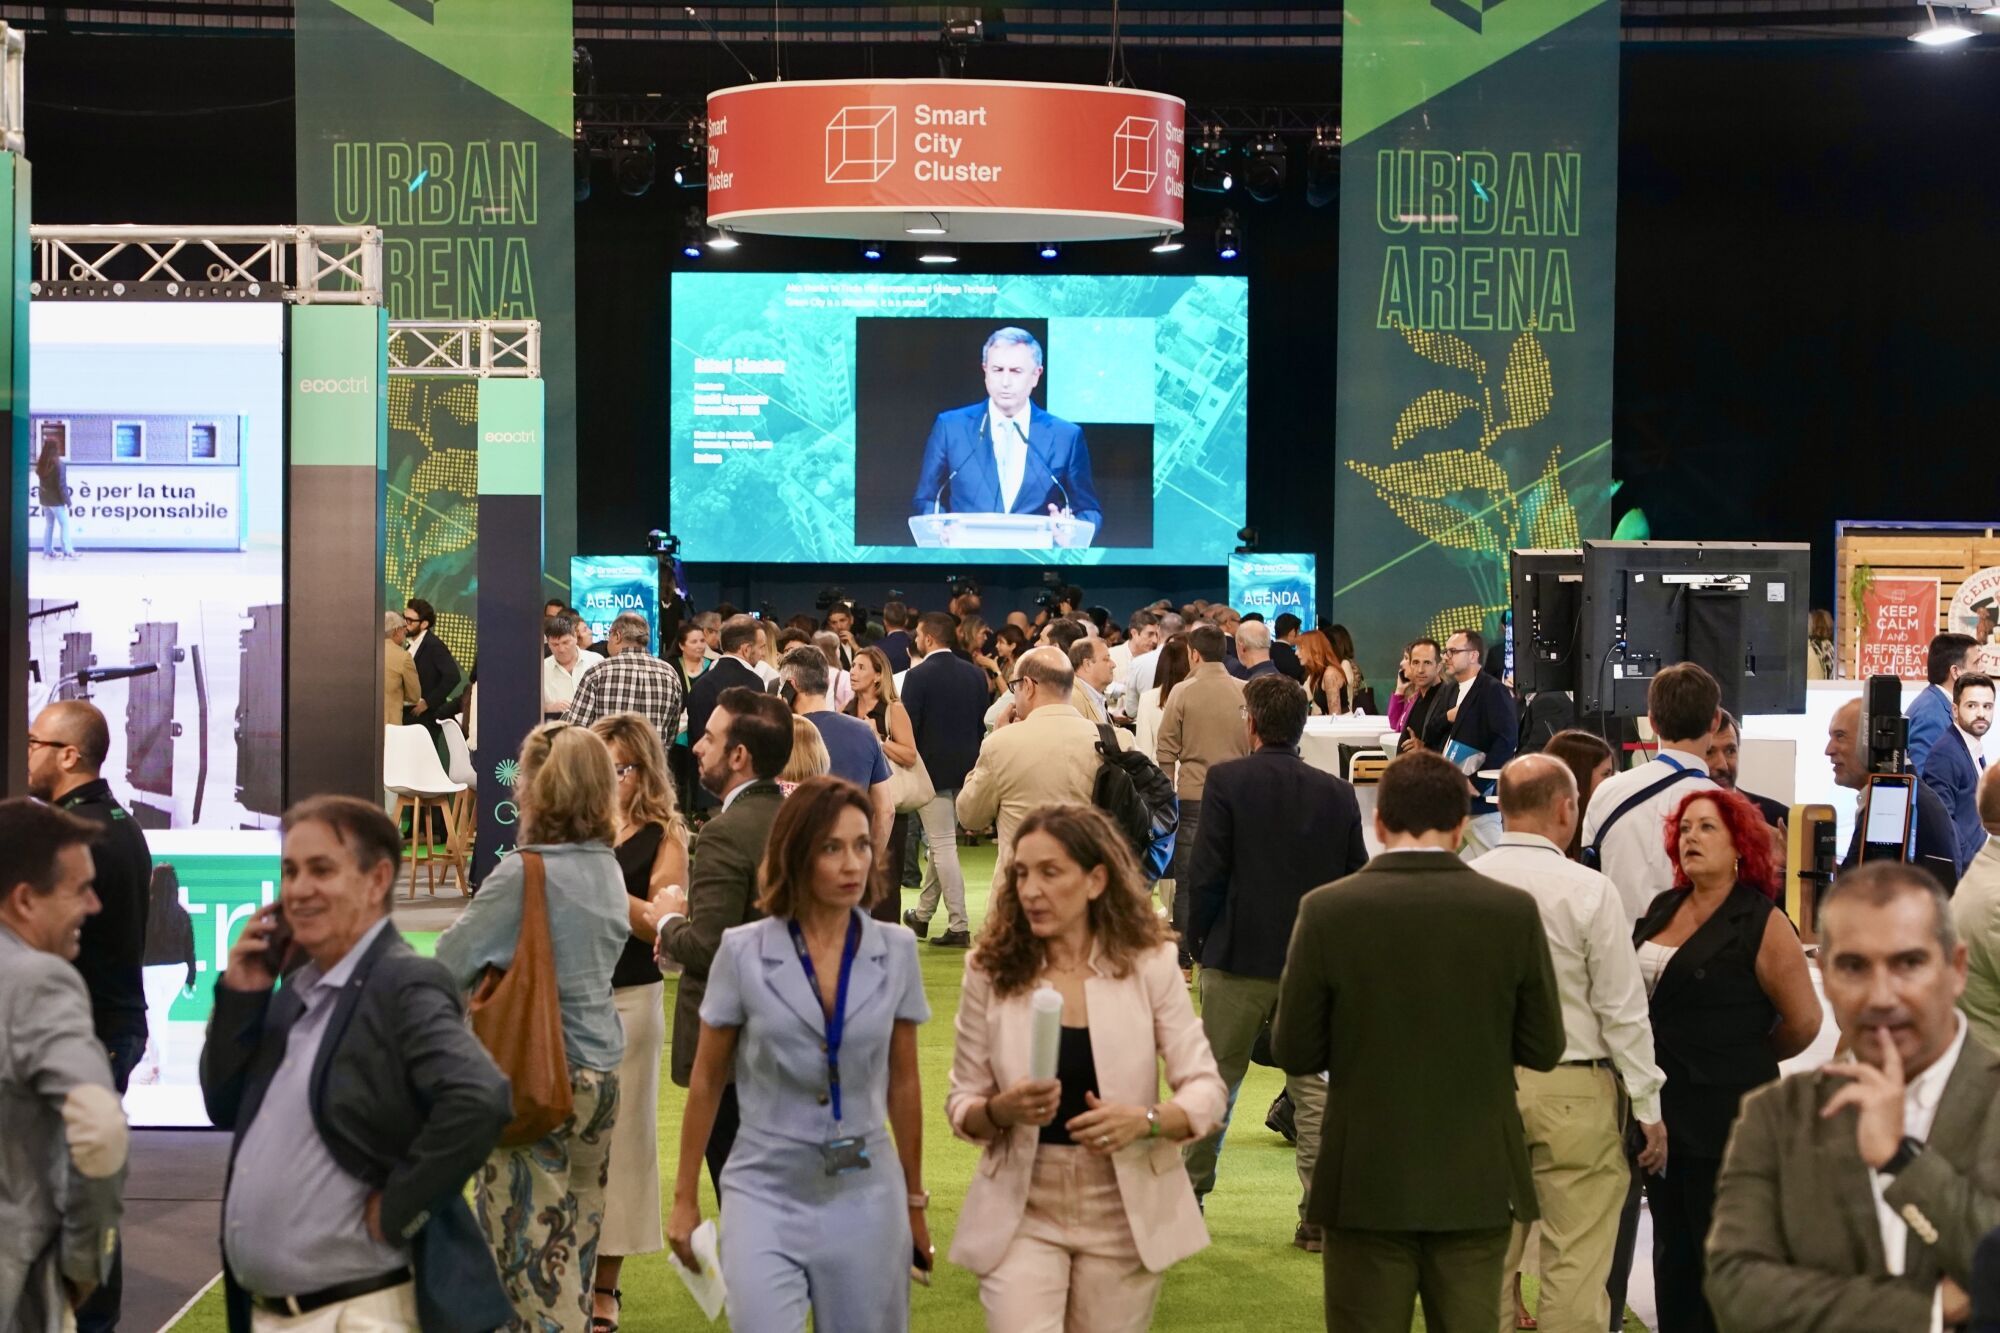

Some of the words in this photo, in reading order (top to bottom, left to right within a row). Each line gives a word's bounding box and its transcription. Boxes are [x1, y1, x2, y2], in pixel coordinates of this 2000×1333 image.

[914, 103, 987, 126] Smart
[914, 132, 963, 158] City
[1165, 148, 1180, 175] City
[914, 160, 1002, 182] Cluster
[333, 141, 538, 226] URBAN
[1377, 149, 1581, 236] URBAN
[1376, 246, 1575, 332] ARENA
[299, 375, 369, 395] ecoctrl
[484, 429, 536, 444] ecoctrl
[96, 486, 133, 501] per
[138, 483, 155, 498] la
[161, 484, 196, 498] tua
[91, 501, 229, 521] responsabile
[585, 593, 644, 608] AGENDA
[1243, 591, 1301, 605] AGENDA
[1880, 605, 1918, 617] KEEP
[1876, 618, 1919, 630] CALM
[1887, 632, 1909, 641] AND
[1864, 643, 1929, 654] REFRESCA
[1872, 654, 1889, 665] TU
[1862, 665, 1880, 675] DE
